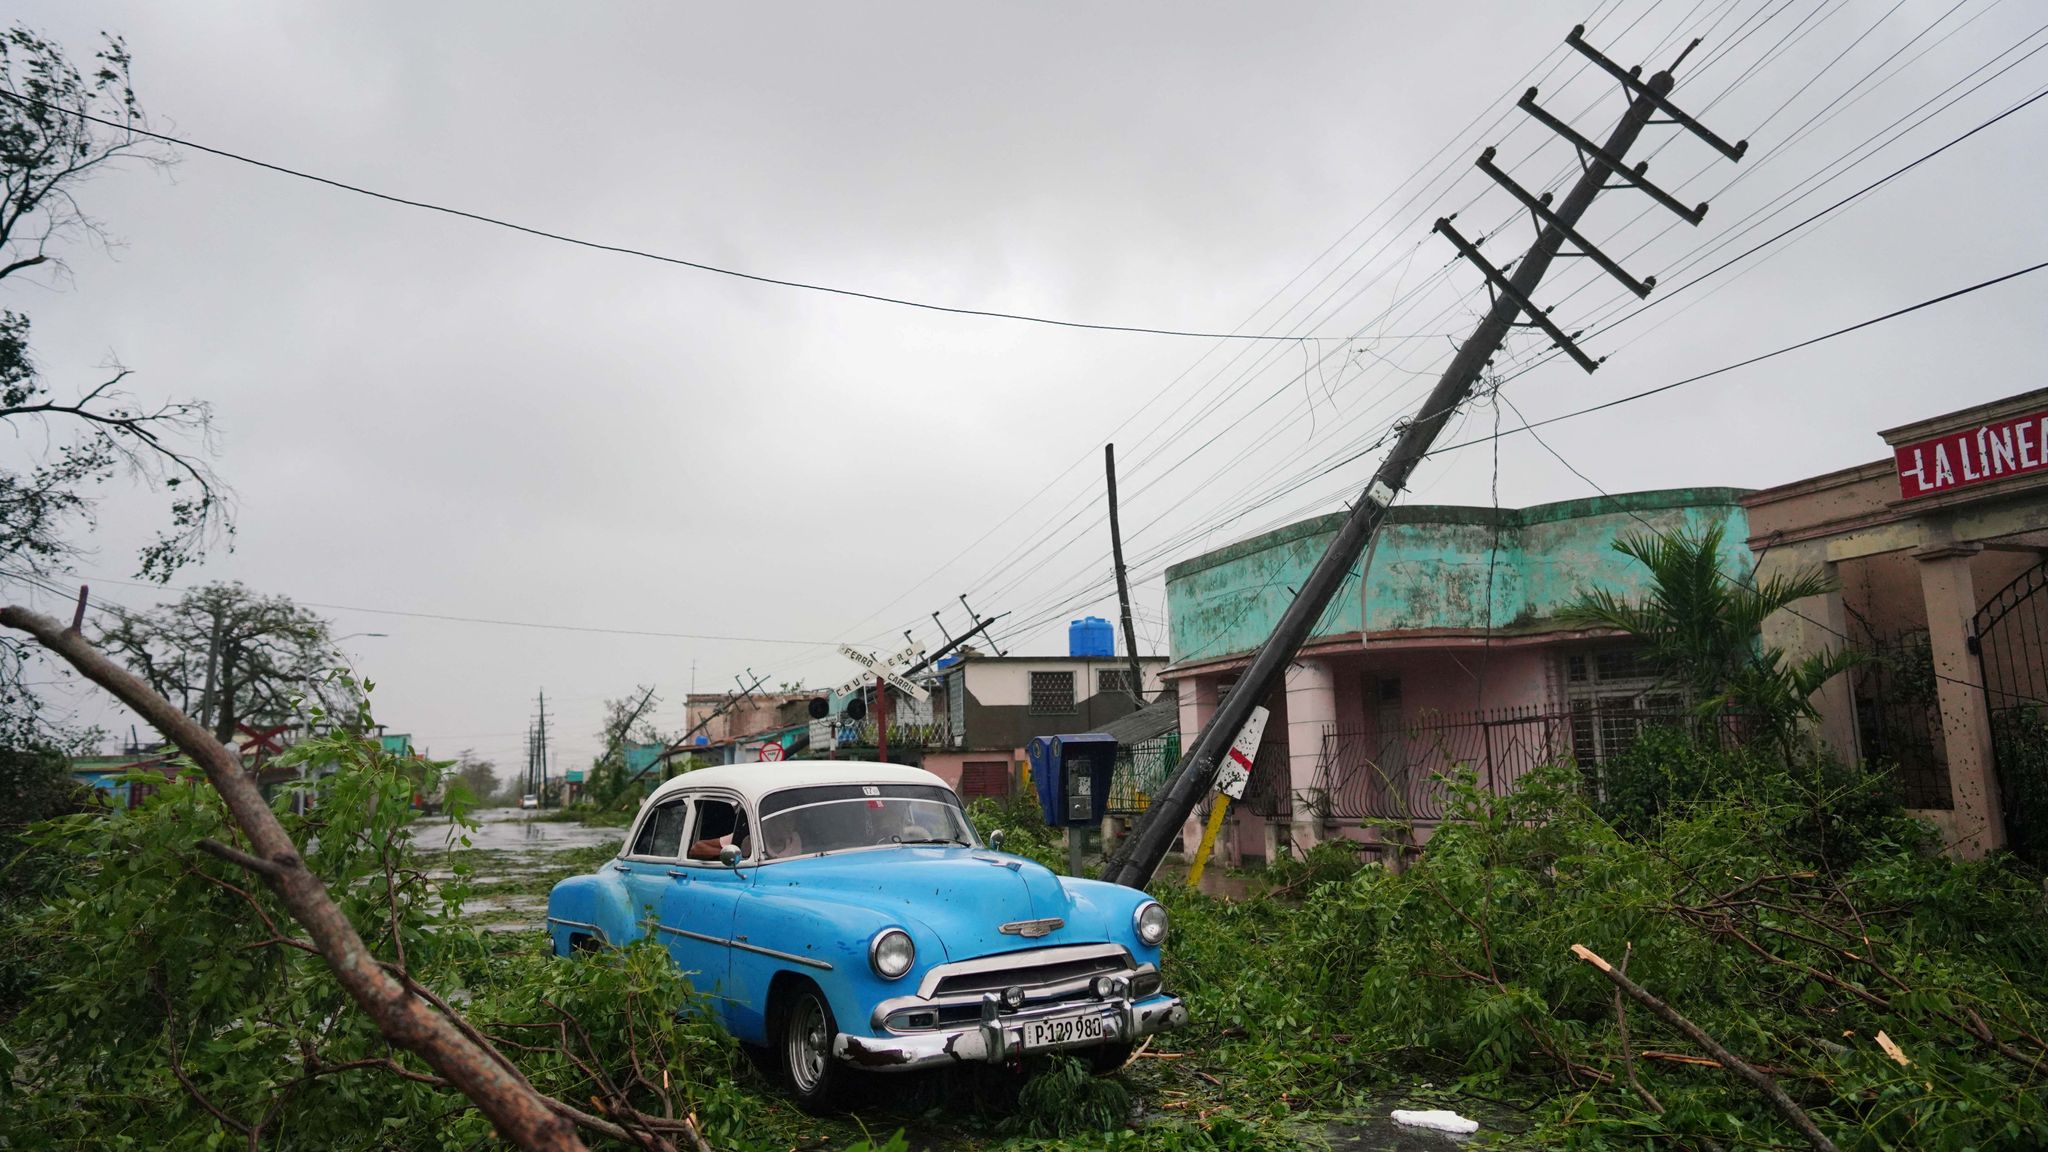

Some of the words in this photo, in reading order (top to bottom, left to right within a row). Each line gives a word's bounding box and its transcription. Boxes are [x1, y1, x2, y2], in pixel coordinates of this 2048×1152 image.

[1912, 443, 1954, 491] LA
[844, 647, 874, 668] FERRO
[887, 672, 915, 695] CARRIL
